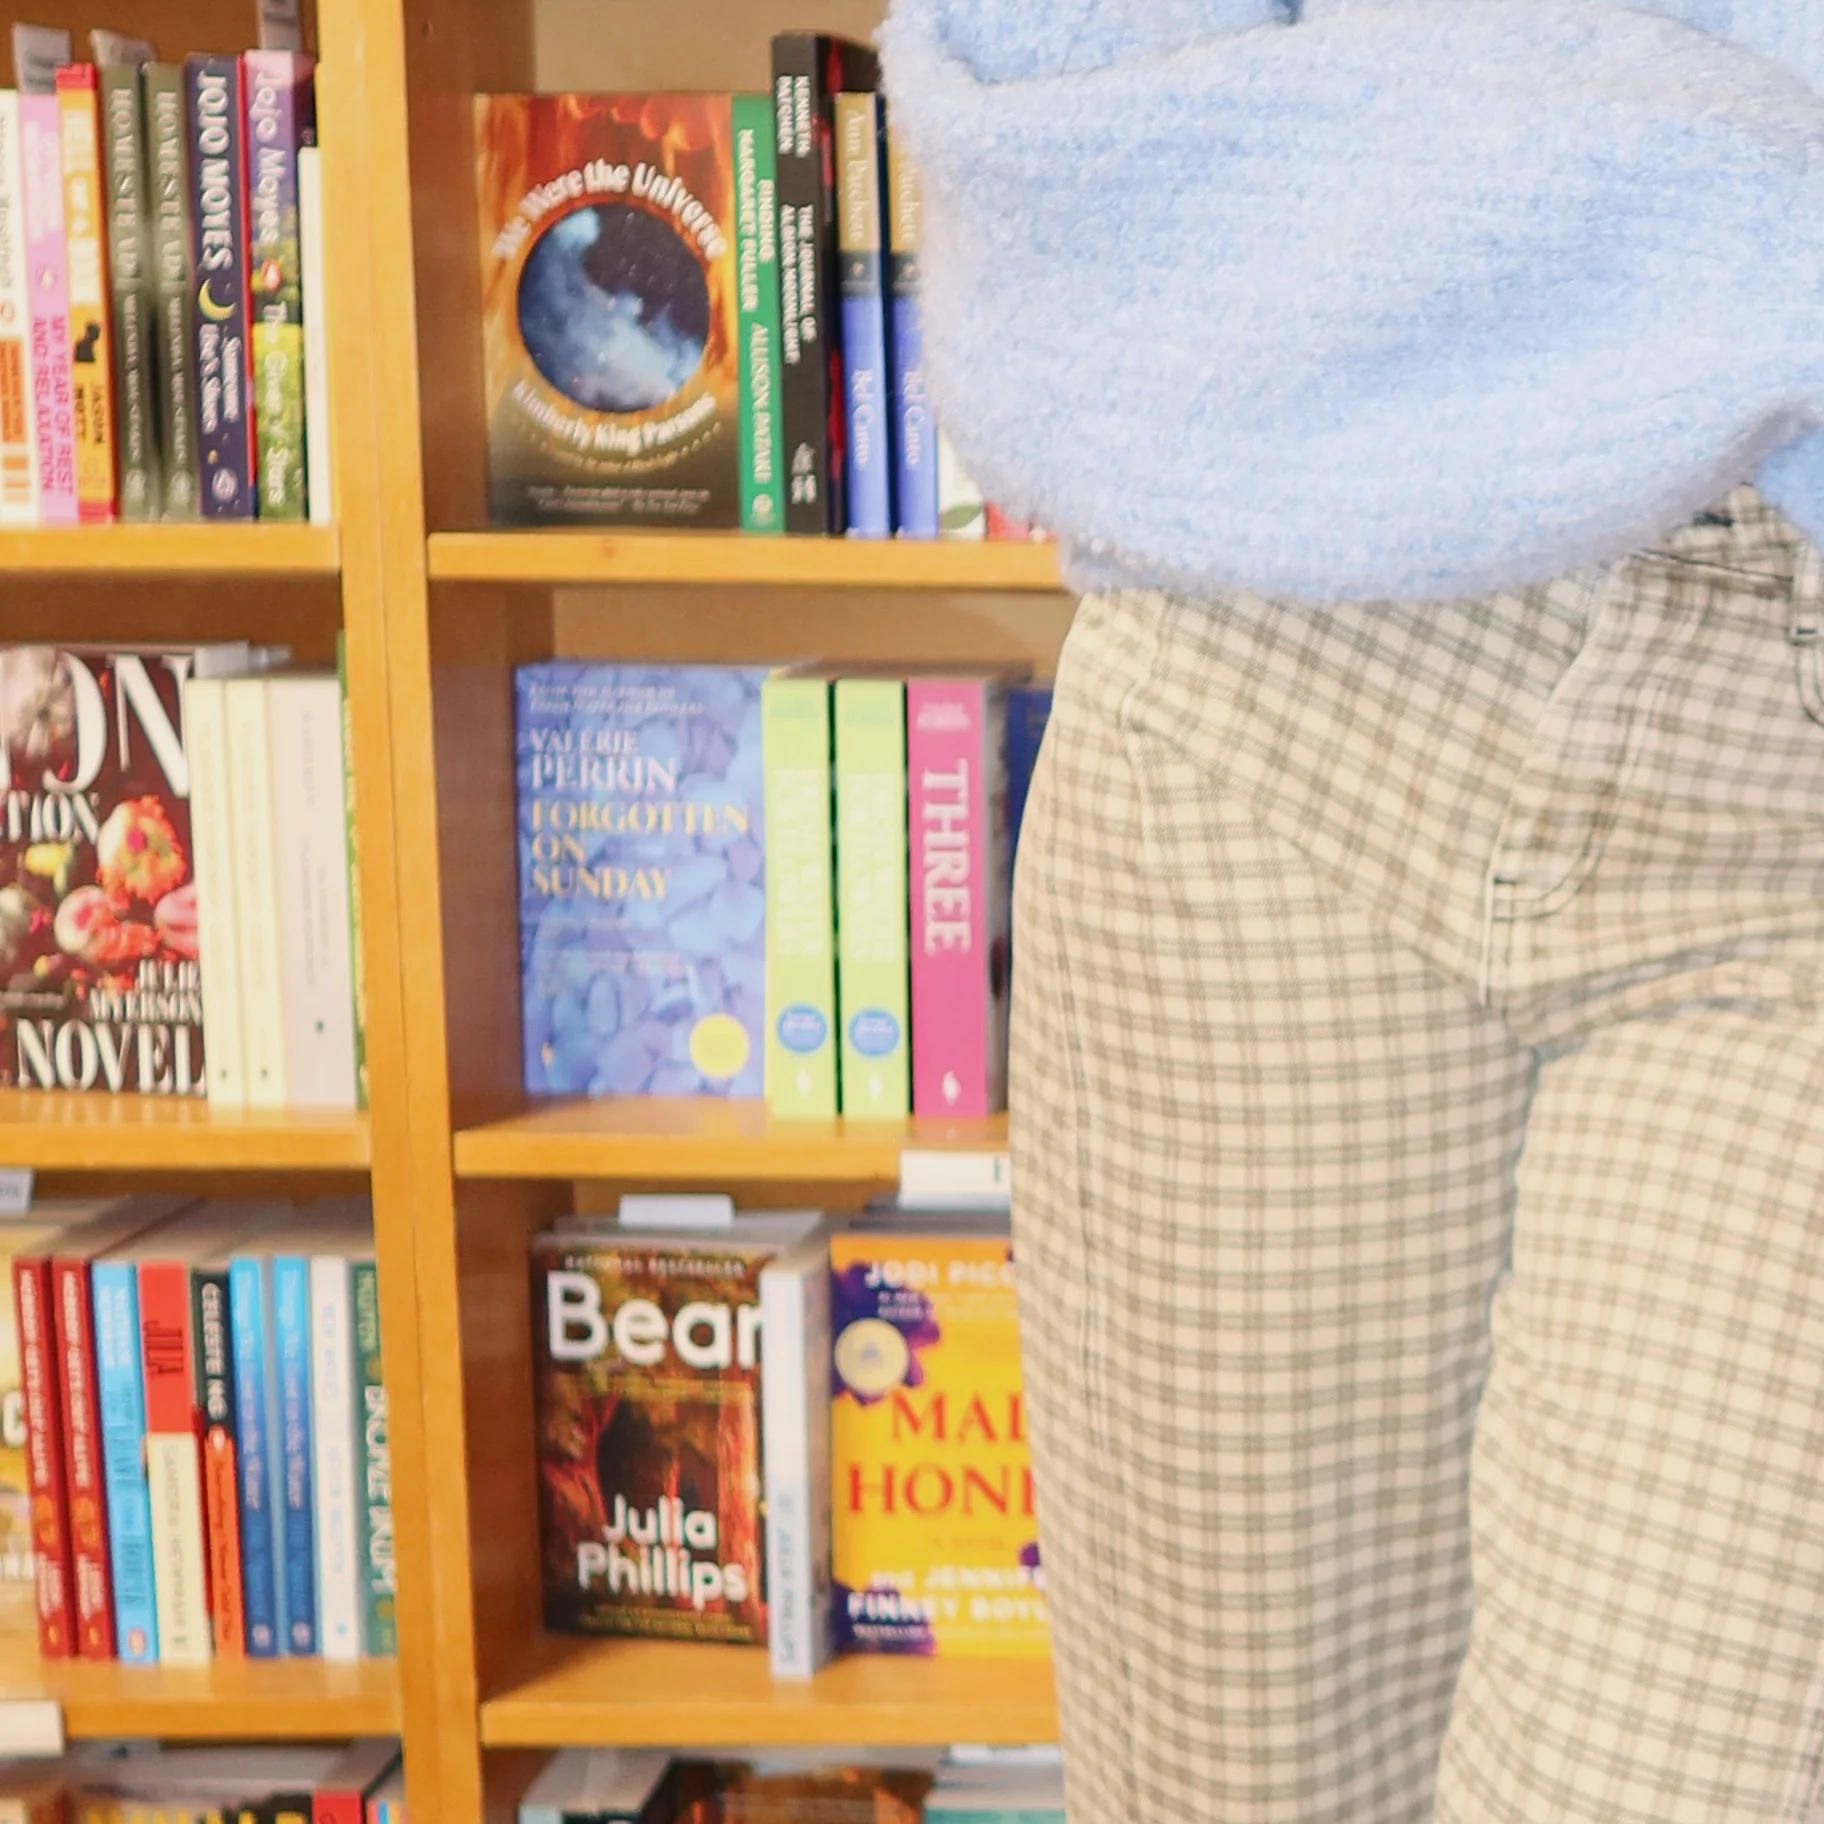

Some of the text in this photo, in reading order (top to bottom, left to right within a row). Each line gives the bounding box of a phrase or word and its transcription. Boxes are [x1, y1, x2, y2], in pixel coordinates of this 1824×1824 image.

[776, 75, 794, 154] PATCHEN
[794, 75, 811, 157] KENNETH
[197, 71, 233, 271] JOJO MOYES
[249, 72, 285, 244] Jojo Moyes
[522, 156, 729, 261] Were the Universe
[738, 129, 759, 311] MARGARET FULLER
[758, 180, 775, 262] FINDING
[846, 160, 868, 241] Patchett
[798, 241, 816, 312] JOURNAL
[511, 379, 718, 455] Kimberly King Parsons
[751, 323, 773, 482] ALLISON PATAKI
[853, 406, 875, 465] Canto
[531, 756, 678, 793] PERRIN
[530, 799, 751, 836] FORGOTTEN
[531, 834, 585, 863] ON
[530, 863, 670, 902] SUNDAY
[921, 759, 973, 957] THREE
[17, 1017, 208, 1094] NOVEL
[864, 1260, 941, 1288] JODI
[201, 1282, 226, 1374] CELESTE
[546, 1271, 764, 1371] Bear
[601, 1495, 719, 1549] Julia
[576, 1543, 749, 1610] Phillips
[846, 1593, 964, 1623] FINNEY
